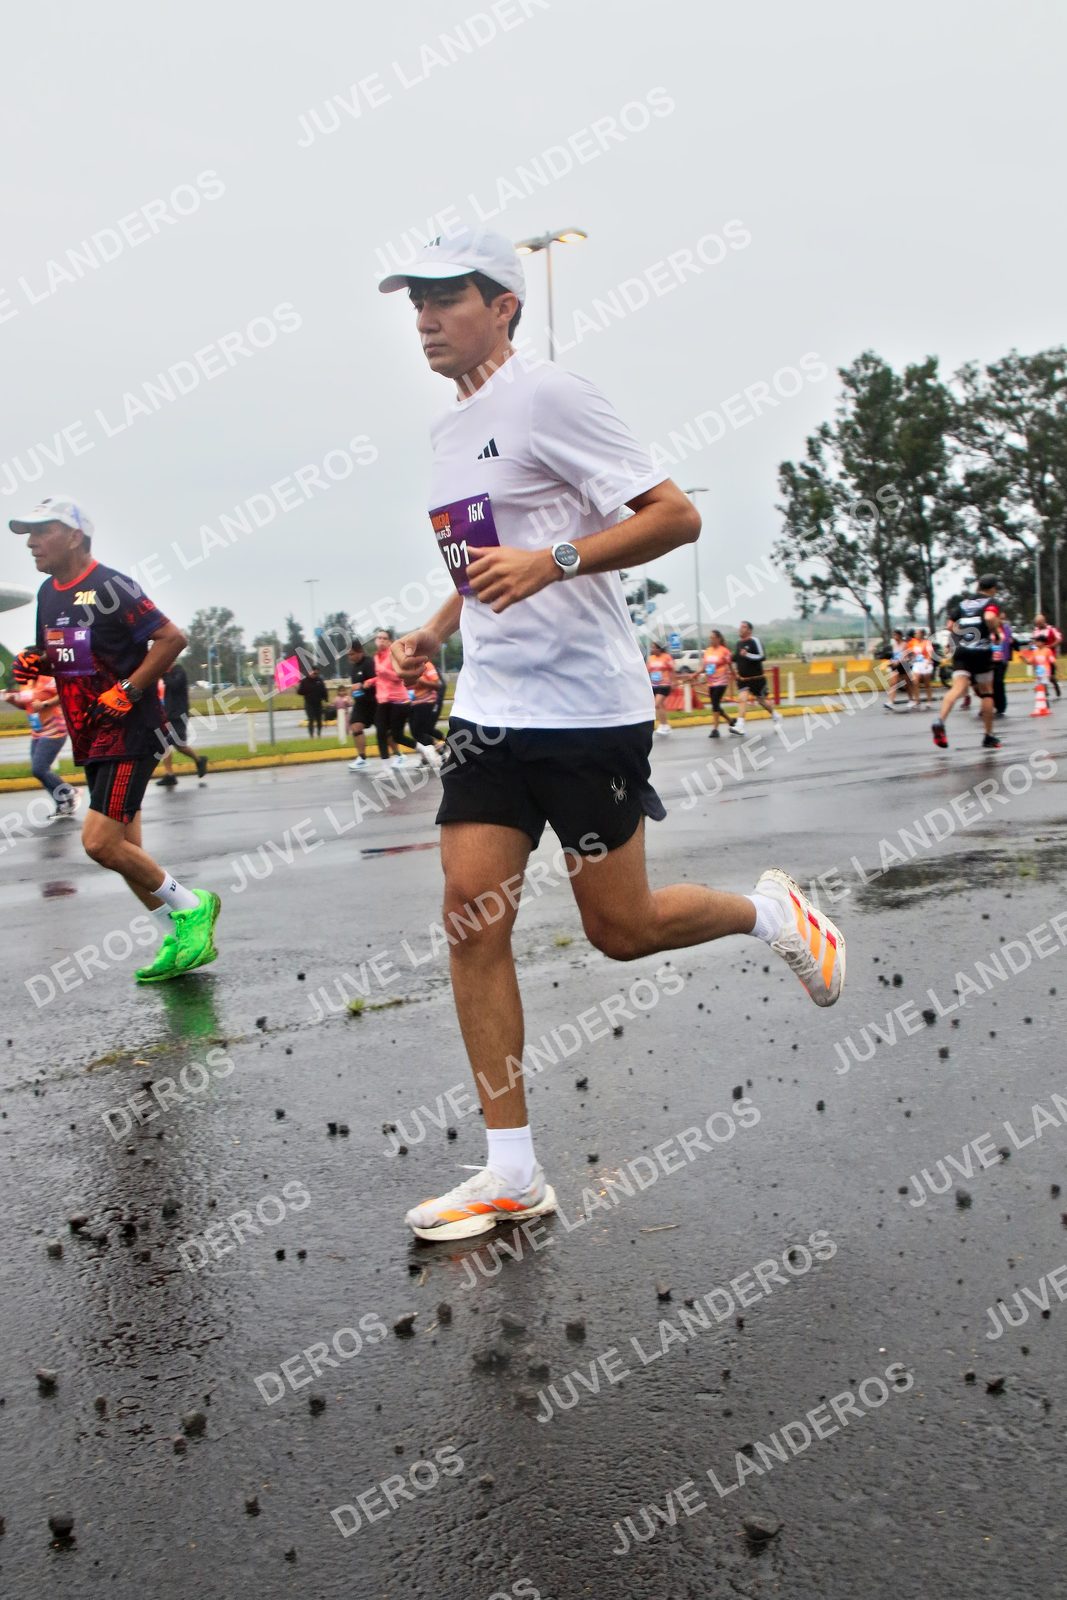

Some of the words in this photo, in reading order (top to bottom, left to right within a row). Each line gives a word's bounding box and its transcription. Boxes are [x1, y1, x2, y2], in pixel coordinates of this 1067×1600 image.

[467, 501, 484, 522] 15K
[443, 540, 470, 570] 701
[74, 590, 96, 604] 21K
[56, 648, 74, 662] 761
